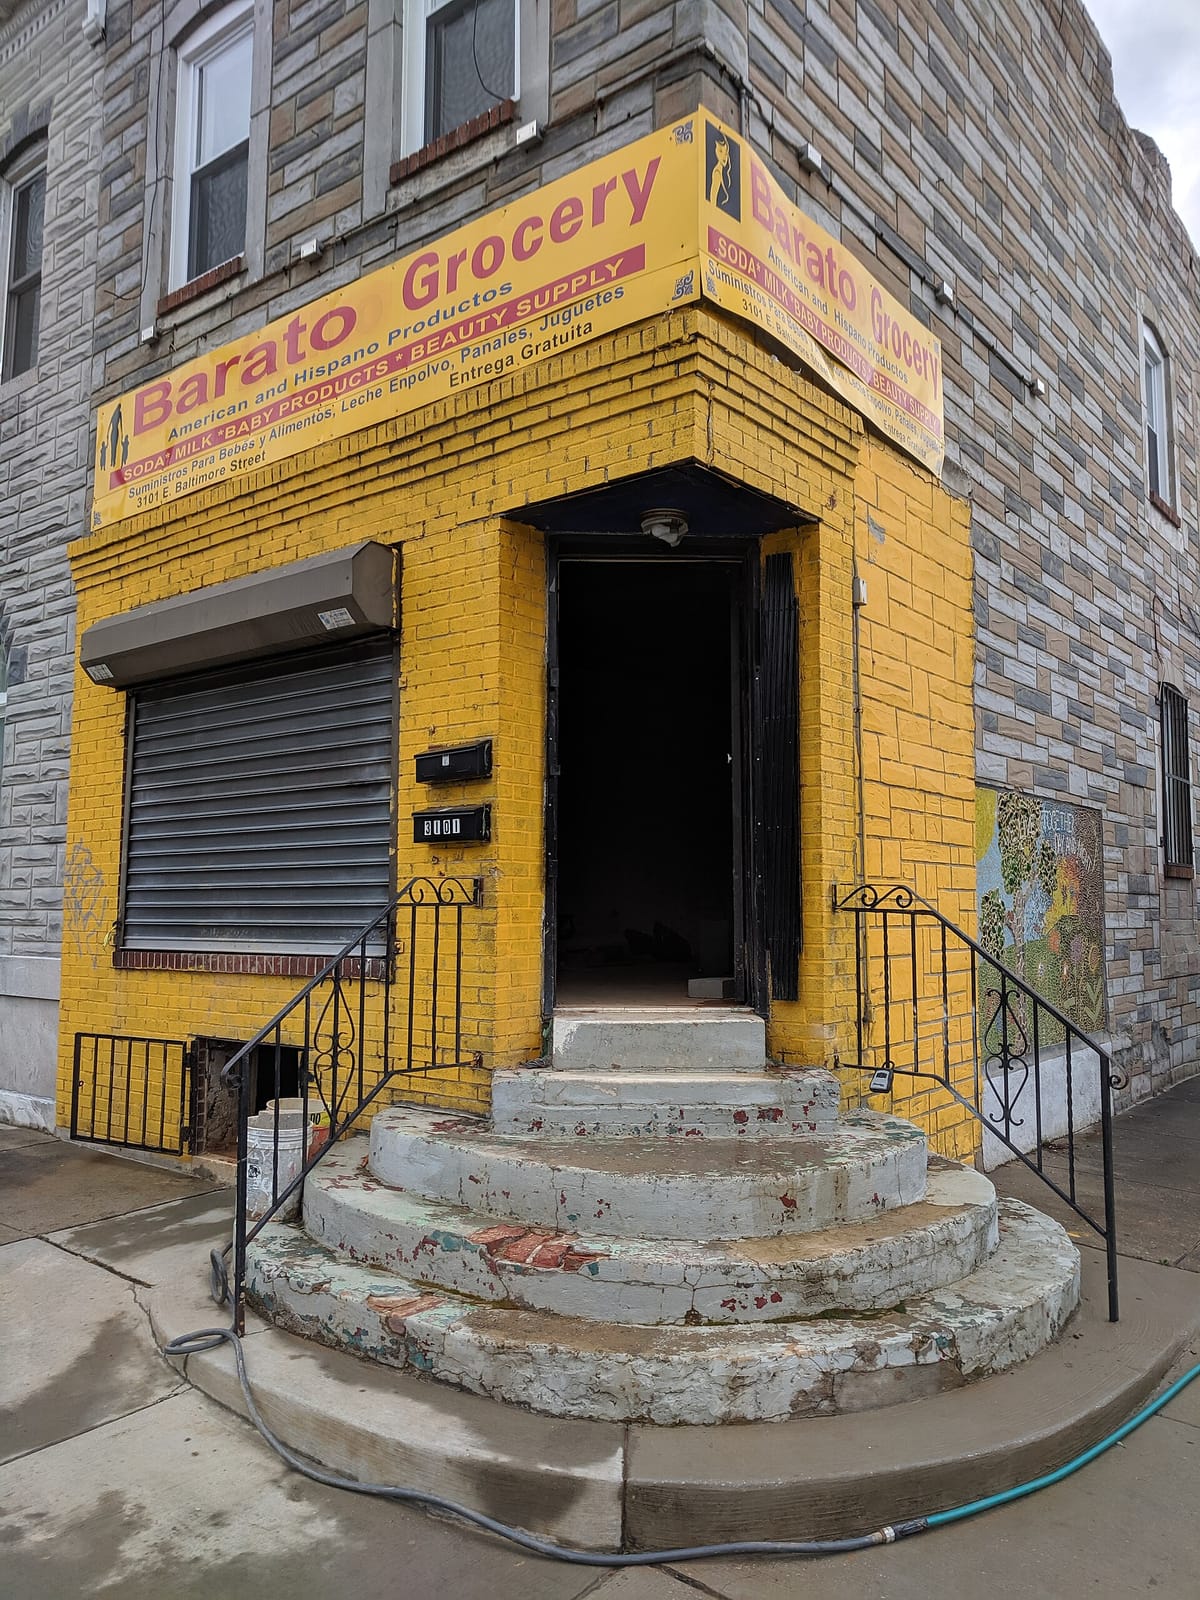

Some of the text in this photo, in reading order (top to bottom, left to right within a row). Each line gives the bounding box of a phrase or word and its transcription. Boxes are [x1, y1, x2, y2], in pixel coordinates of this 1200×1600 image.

[134, 156, 661, 436] Barato Grocery
[450, 321, 593, 387] Entrega Gratuita
[708, 259, 767, 307] Suministros
[742, 298, 763, 320] 3101
[751, 160, 939, 400] Barato Grocery
[764, 269, 789, 305] MILK
[873, 374, 908, 408] BEAUTY
[909, 398, 938, 430] SUPPLY
[768, 246, 809, 299] American
[812, 295, 828, 315] and
[834, 308, 866, 349] Hispano
[868, 341, 908, 384] Productos
[128, 467, 188, 498] Suministros
[192, 455, 215, 472] Para
[259, 435, 266, 448] y
[269, 408, 336, 441] Alimentos,
[342, 387, 382, 413] Leche
[390, 360, 455, 393] Enpolvo,
[461, 328, 532, 363] Panales,
[540, 284, 625, 332] Juguetes
[168, 282, 513, 442] American and Hispano Productos
[175, 433, 213, 460] MILK
[279, 361, 389, 416] PRODUCTS
[411, 308, 510, 361] BEAUTY
[517, 258, 625, 316] SUPPLY
[137, 450, 266, 508] 3101 E. Baltimore Street
[425, 820, 459, 834] 3101
